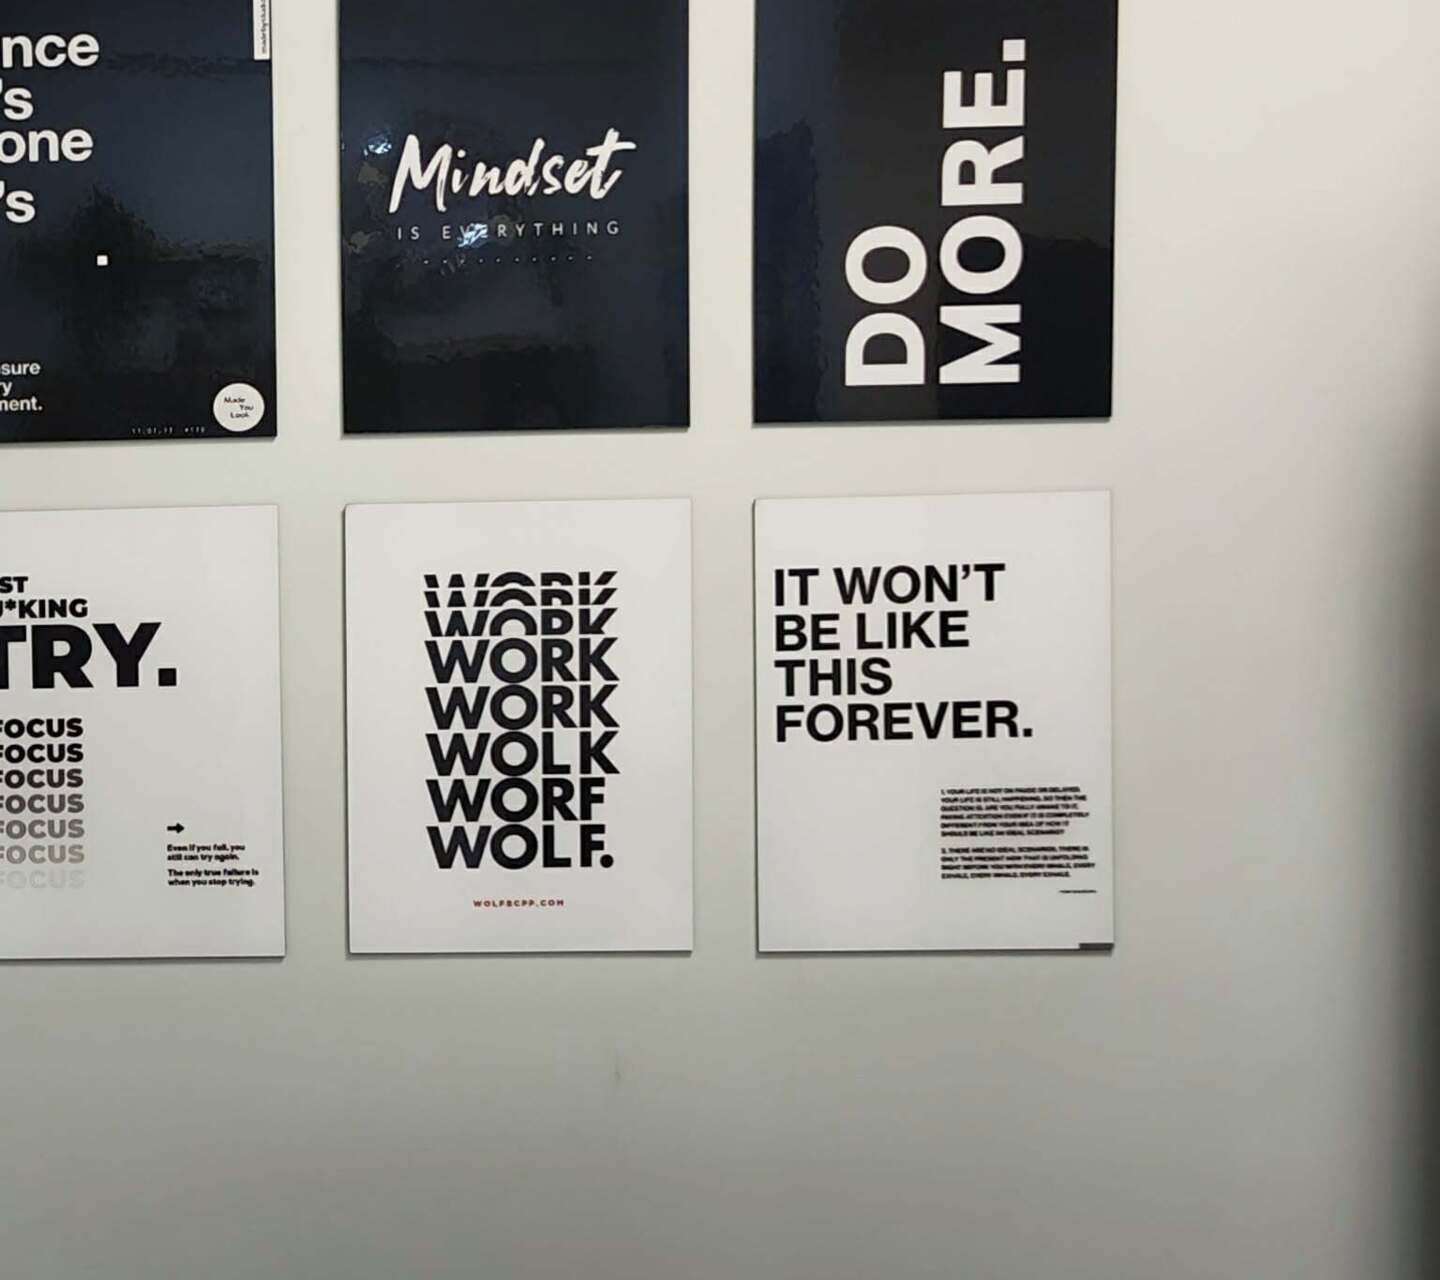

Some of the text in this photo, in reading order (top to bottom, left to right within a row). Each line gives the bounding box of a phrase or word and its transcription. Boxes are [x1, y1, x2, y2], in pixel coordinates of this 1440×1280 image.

[388, 129, 635, 212] Mindset
[396, 225, 421, 241] IS
[940, 40, 1025, 383] MORE.
[846, 226, 926, 385] DO
[775, 563, 1005, 606] IT WON'T
[776, 610, 969, 651] BE LIKE
[425, 637, 619, 685] WORK
[774, 657, 892, 696] THIS
[425, 682, 619, 731] WORK
[777, 700, 1032, 742] FOREVER.
[426, 728, 620, 778] WOLK
[426, 775, 605, 822] WORF
[427, 824, 614, 869] WOLF.
[167, 868, 183, 877] The
[168, 878, 191, 886] when
